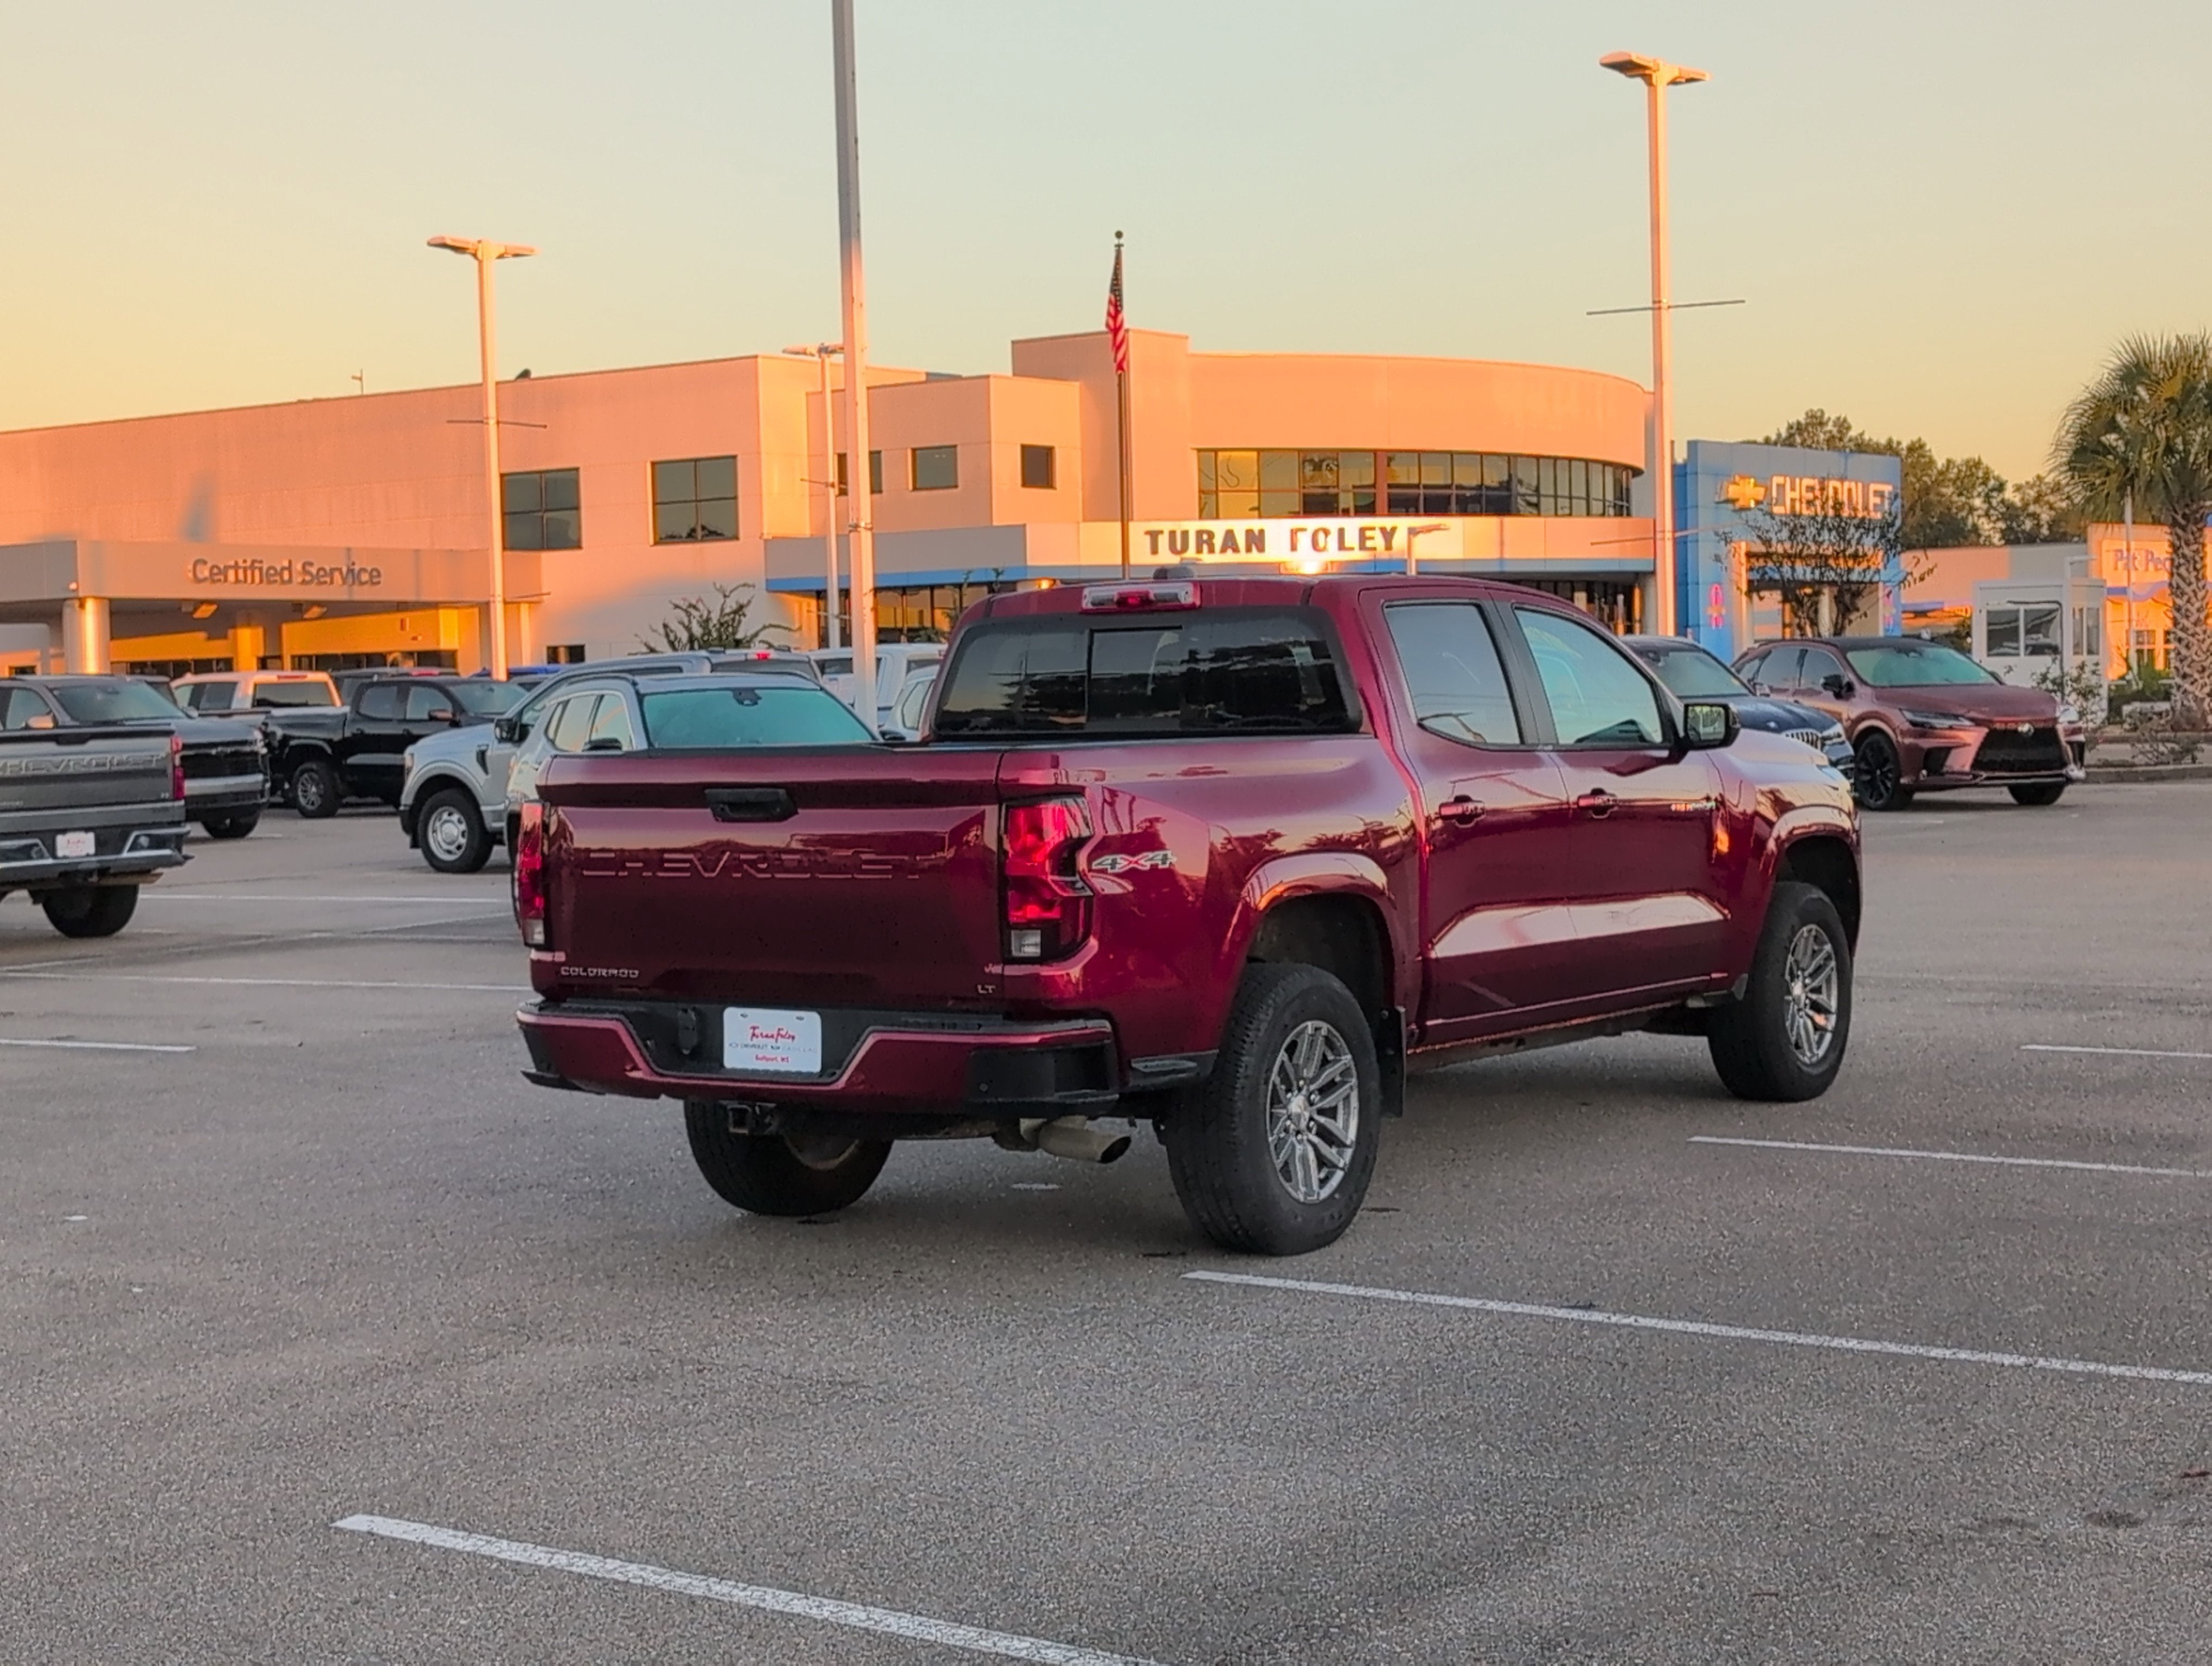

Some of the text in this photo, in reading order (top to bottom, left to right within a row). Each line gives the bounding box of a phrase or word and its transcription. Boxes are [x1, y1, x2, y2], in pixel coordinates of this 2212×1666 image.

[1144, 528, 1266, 556] TURAN
[192, 558, 382, 587] Certified Service
[2145, 549, 2172, 571] Pec
[582, 850, 942, 879] CHEVROLET
[561, 966, 640, 978] COLORADO
[976, 984, 996, 994] LT
